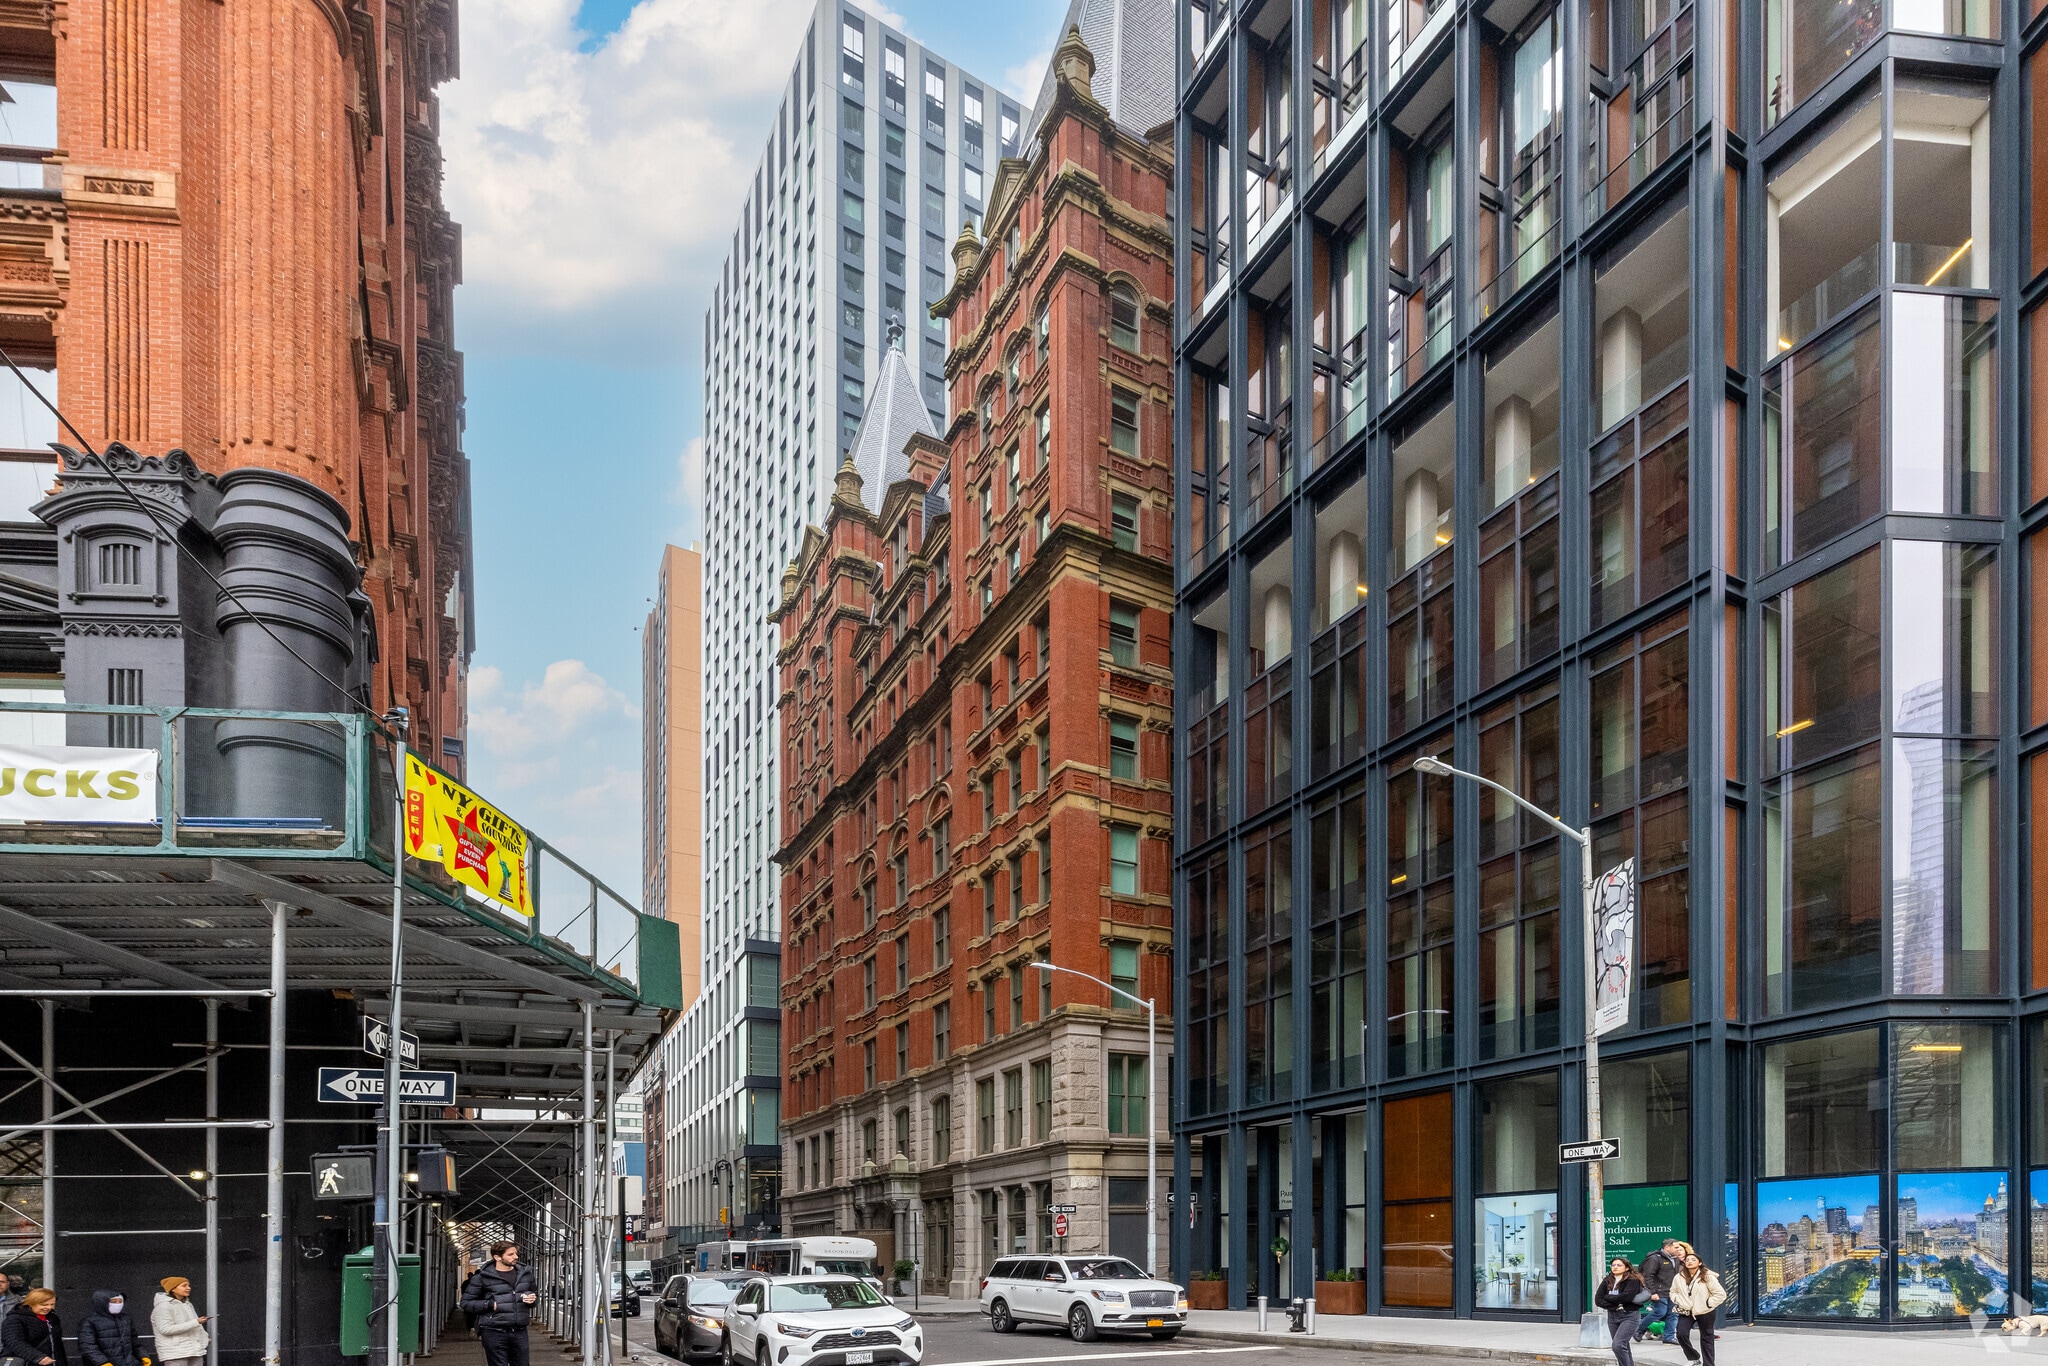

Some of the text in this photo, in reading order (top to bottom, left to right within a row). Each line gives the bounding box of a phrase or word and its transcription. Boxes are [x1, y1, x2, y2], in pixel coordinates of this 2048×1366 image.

[411, 761, 522, 846] I NY GIFTS
[410, 793, 420, 836] OPEN
[458, 821, 489, 852] FREE
[457, 852, 487, 873] PURCHASE
[402, 1041, 412, 1056] AY
[345, 1079, 436, 1094] ONE WAY
[1568, 1145, 1610, 1157] ONE WAY
[1604, 1223, 1672, 1234] ondominiums
[1609, 1236, 1631, 1246] Sale
